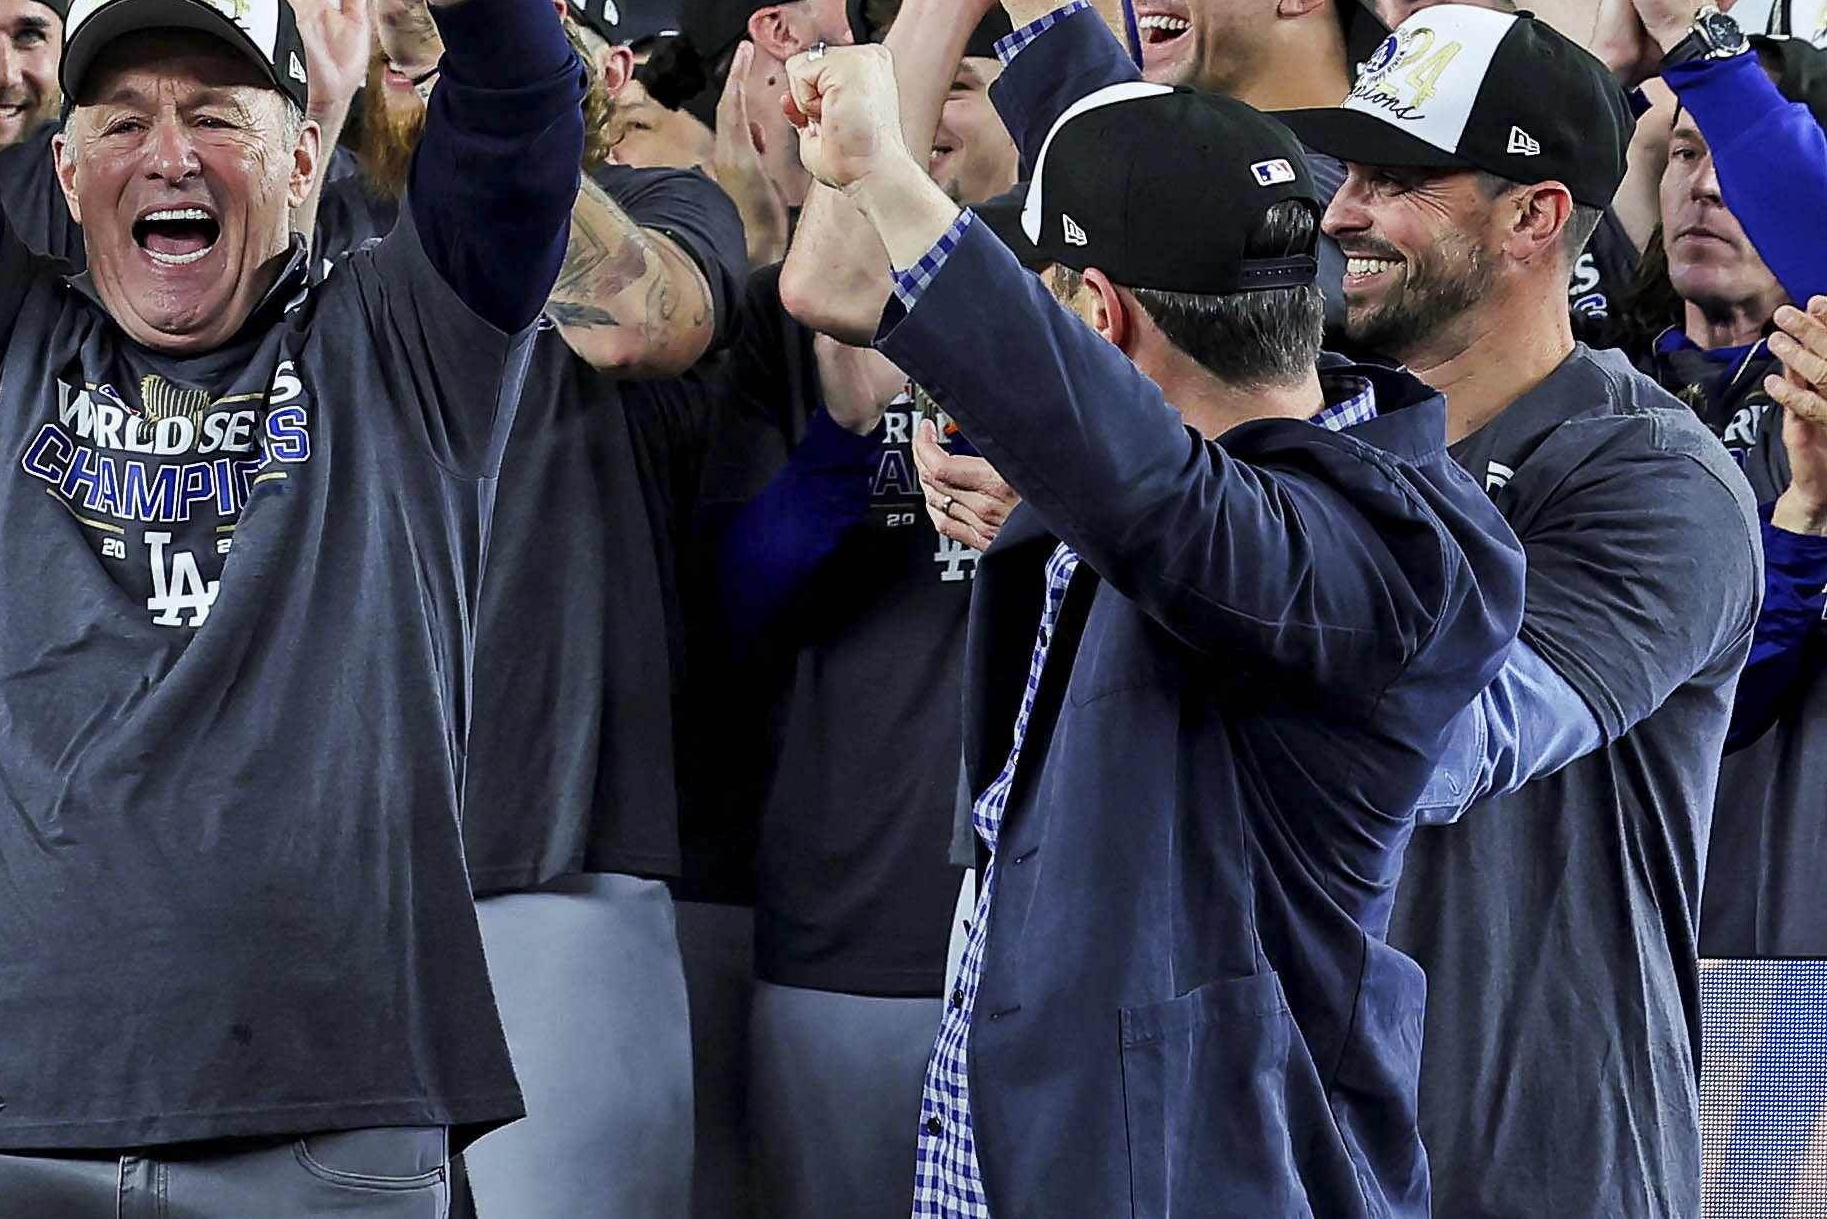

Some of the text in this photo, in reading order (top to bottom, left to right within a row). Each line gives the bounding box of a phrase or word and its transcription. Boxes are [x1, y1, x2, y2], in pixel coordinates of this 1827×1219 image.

[57, 378, 197, 455] WRLD
[886, 513, 916, 527] 20
[101, 537, 126, 559] 20
[216, 538, 233, 554] 2
[144, 531, 221, 627] LA
